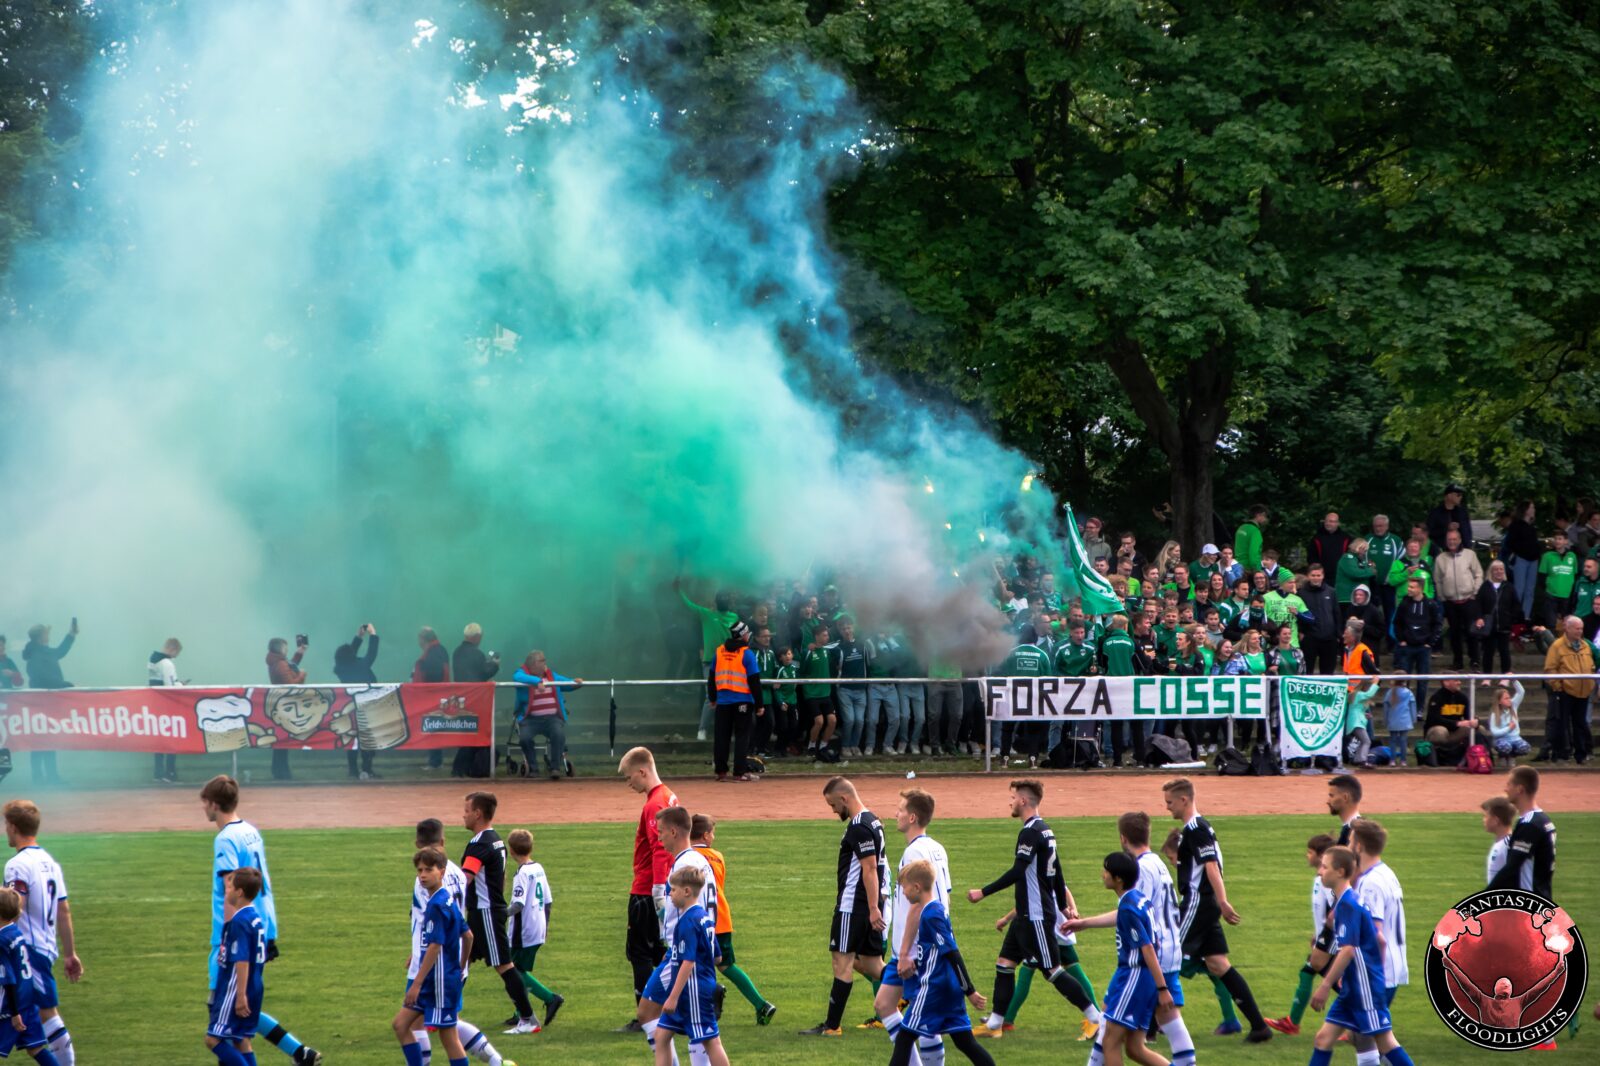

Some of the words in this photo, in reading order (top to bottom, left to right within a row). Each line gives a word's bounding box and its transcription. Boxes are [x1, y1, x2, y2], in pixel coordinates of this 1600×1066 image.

[986, 679, 1112, 716] FORZA
[1134, 678, 1261, 714] COSSE
[1291, 699, 1334, 722] TSV
[1046, 839, 1057, 877] 2
[20, 944, 32, 980] 3
[256, 929, 265, 963] 5
